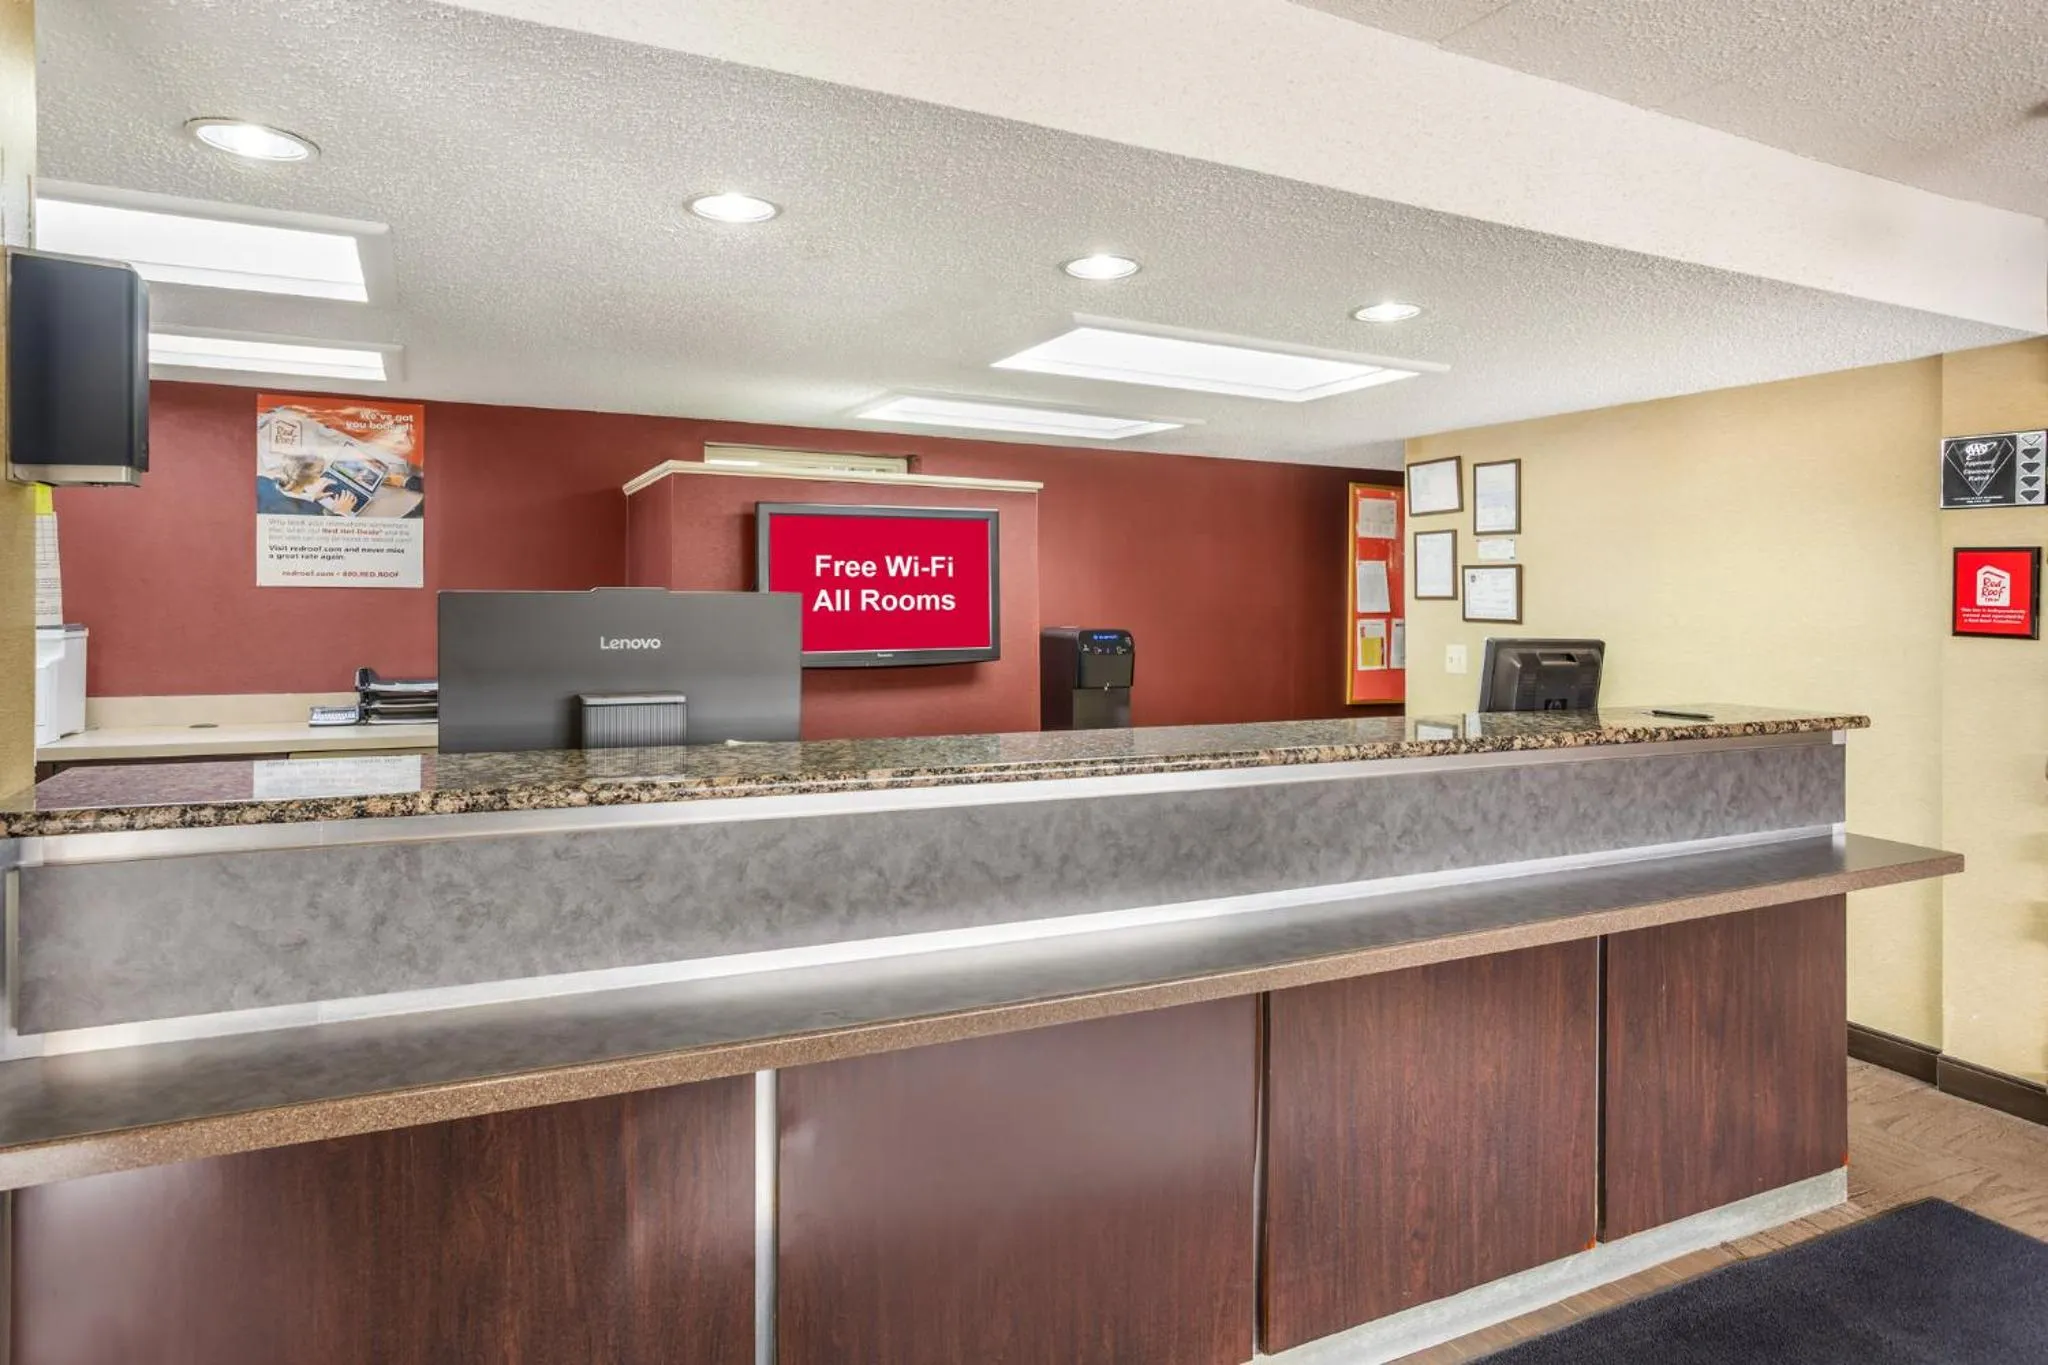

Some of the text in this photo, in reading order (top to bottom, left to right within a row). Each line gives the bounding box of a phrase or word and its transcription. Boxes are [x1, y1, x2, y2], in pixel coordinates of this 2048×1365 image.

[394, 414, 414, 422] got
[345, 420, 367, 430] you
[815, 555, 954, 578] Free Wi-Fi
[1983, 578, 2002, 588] Red
[1981, 586, 2006, 599] Roof
[812, 589, 956, 612] All Rooms
[600, 636, 661, 650] Lenovo
